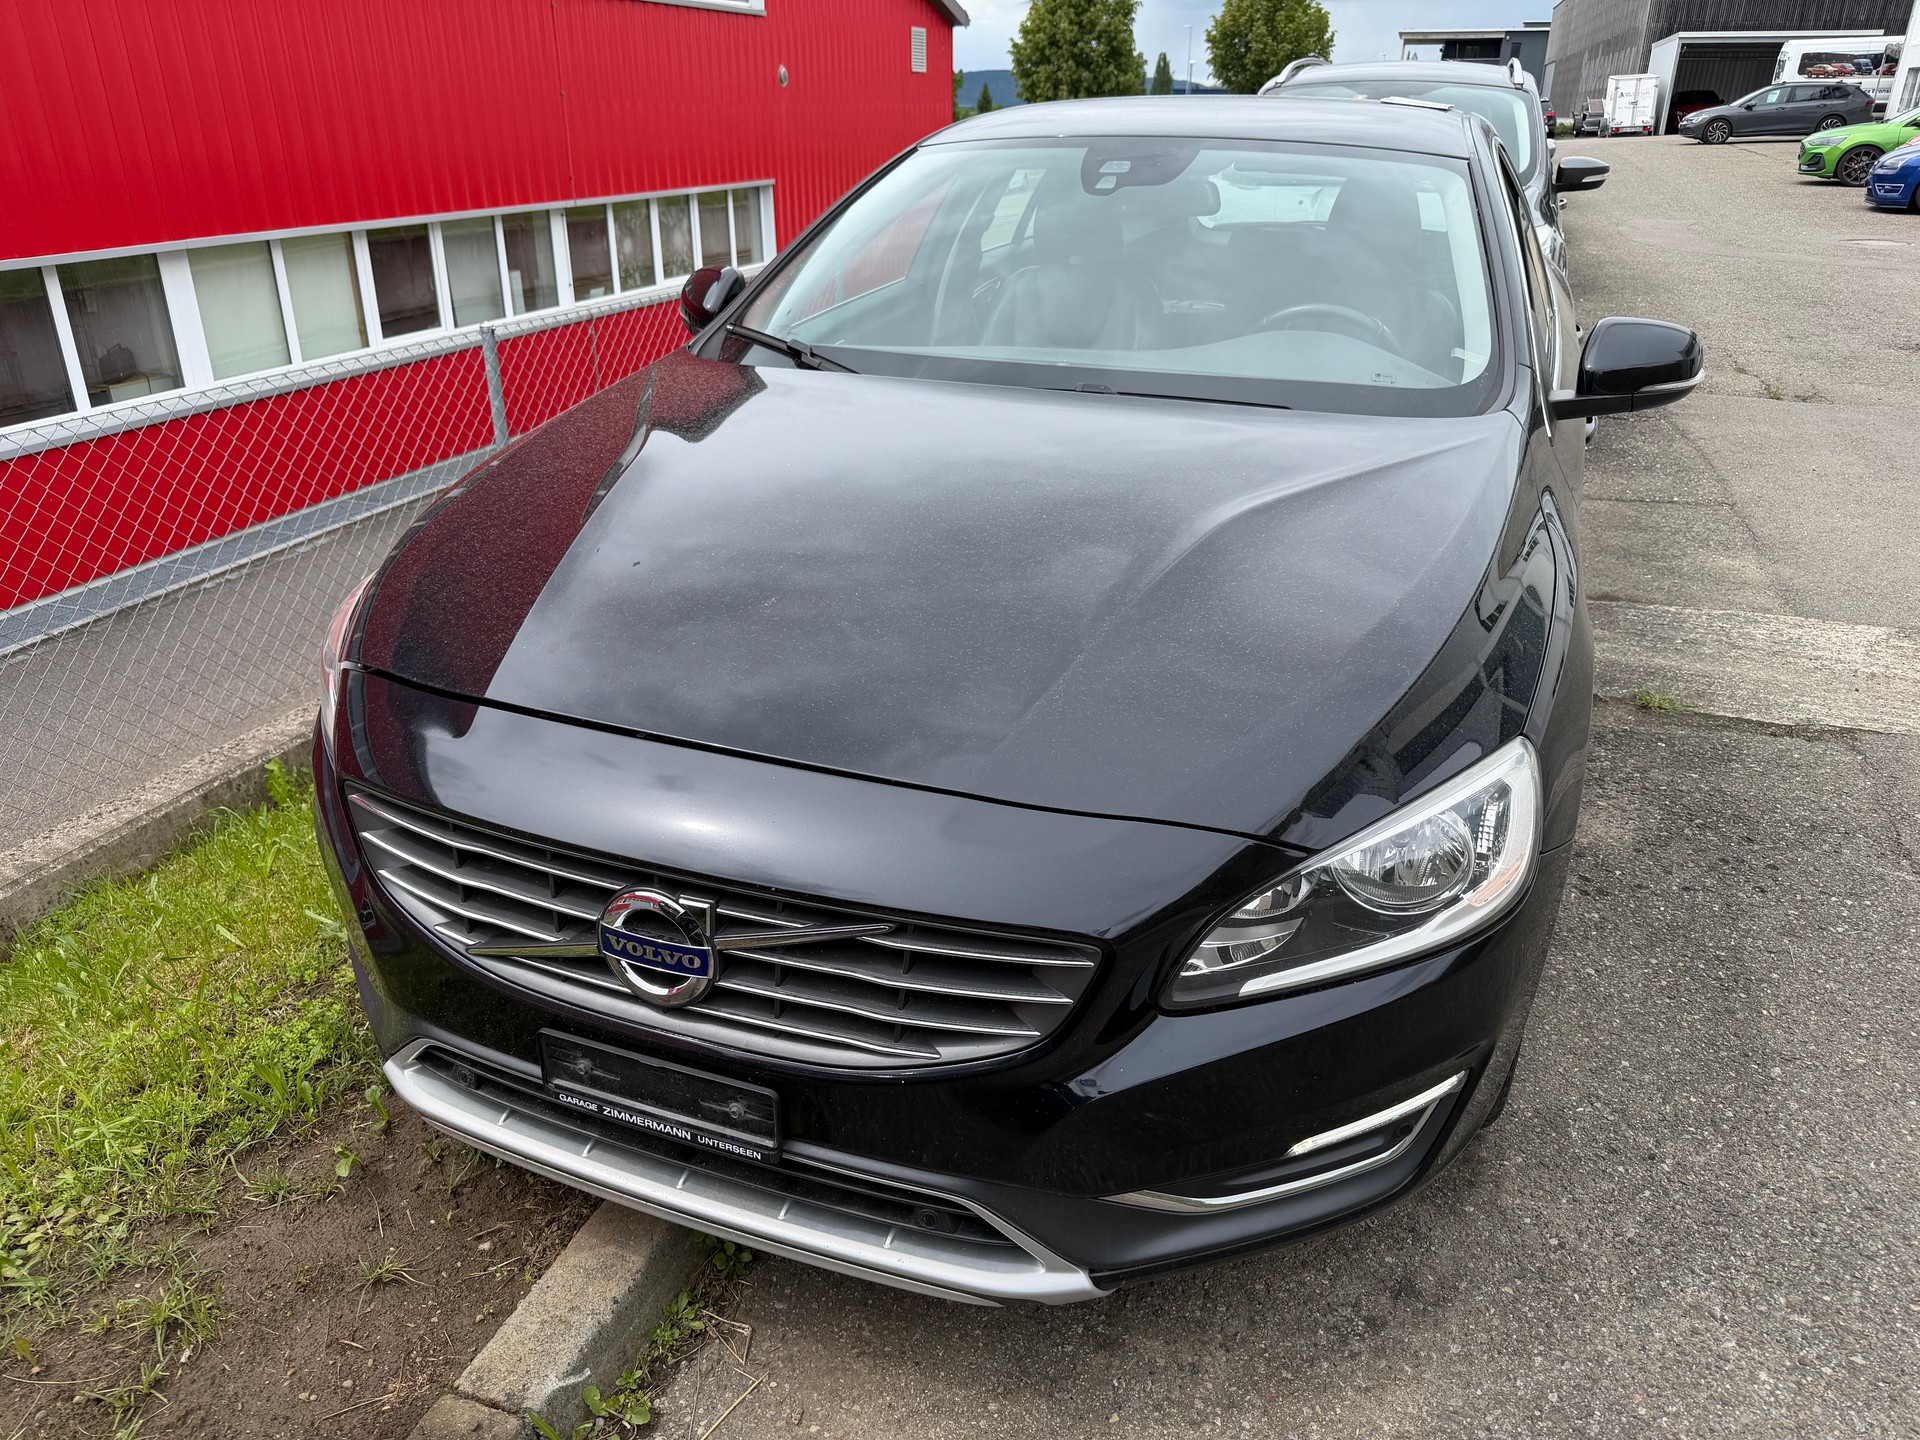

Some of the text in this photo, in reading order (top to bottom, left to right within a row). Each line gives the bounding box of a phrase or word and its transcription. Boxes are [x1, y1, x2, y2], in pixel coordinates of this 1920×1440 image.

[606, 933, 702, 969] VOLVO
[559, 1093, 762, 1160] GARAGE ZIMMERMANN UNTERSEEN
